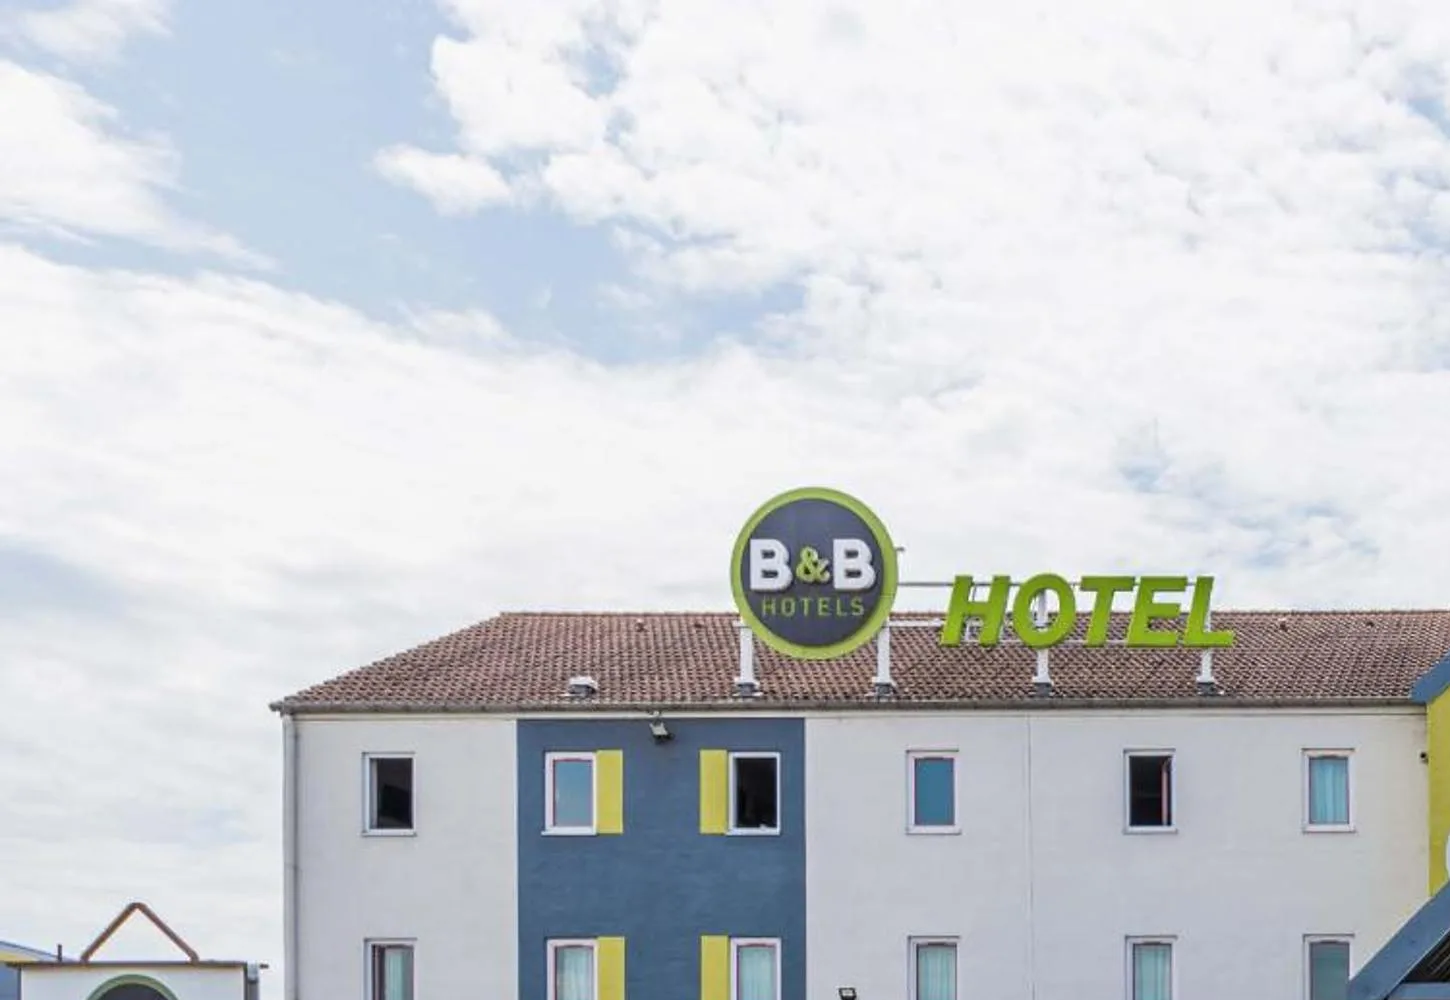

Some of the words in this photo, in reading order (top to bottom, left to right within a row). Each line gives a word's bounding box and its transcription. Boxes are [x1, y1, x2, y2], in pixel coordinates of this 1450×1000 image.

[750, 538, 876, 591] B&B
[761, 596, 865, 617] HOTELS
[940, 573, 1236, 649] HOTEL
